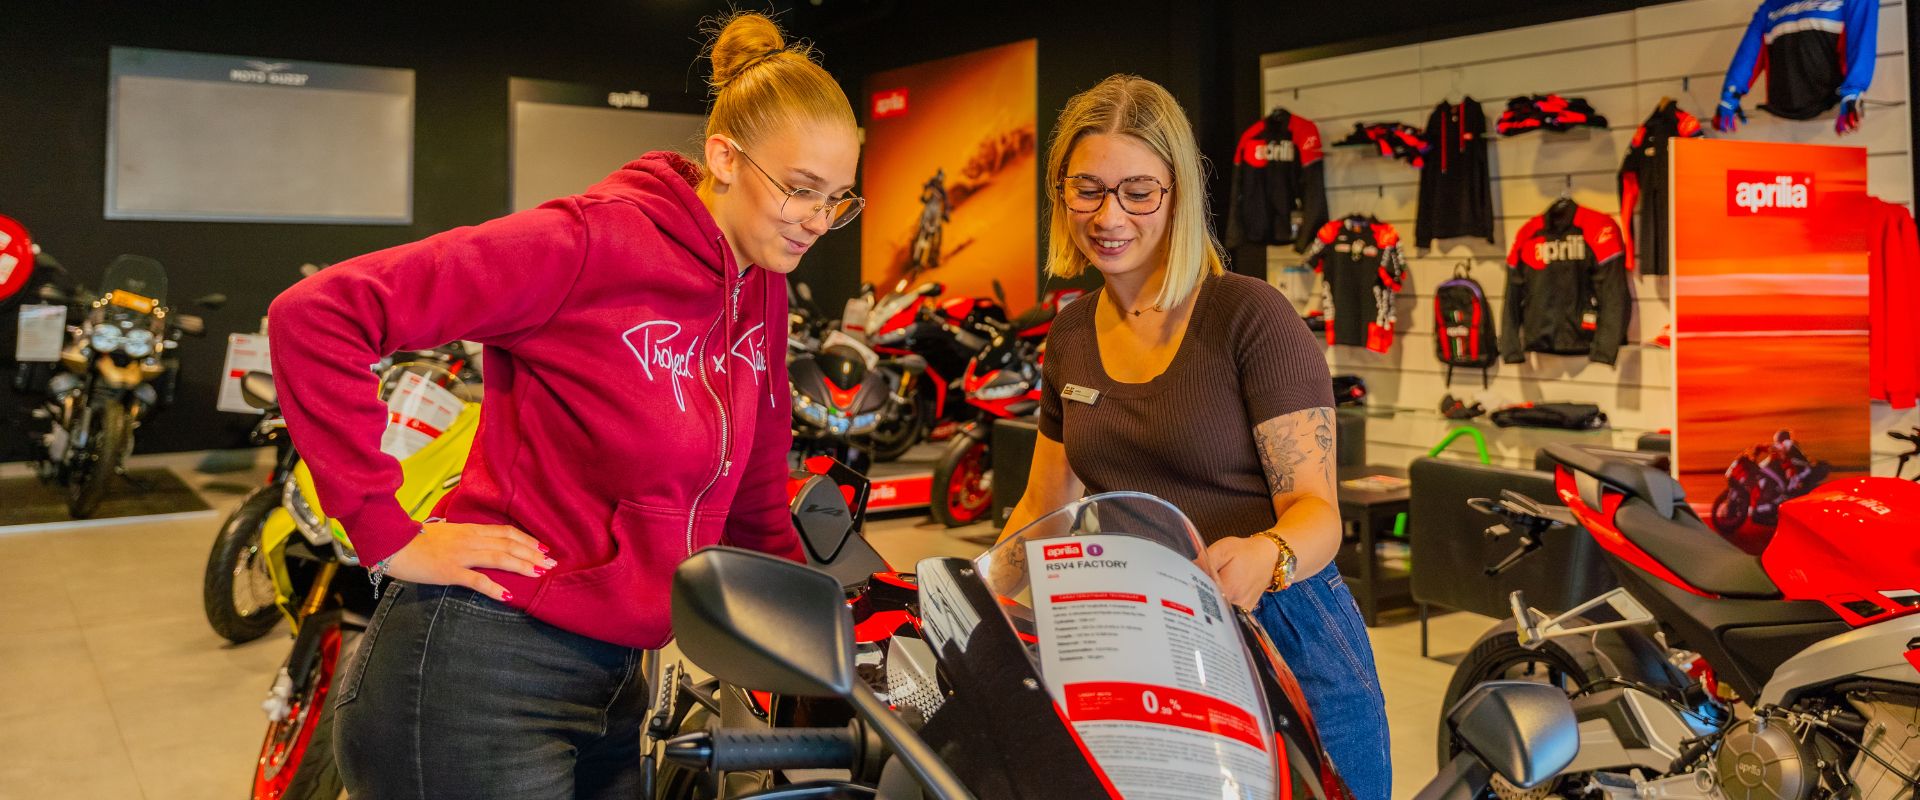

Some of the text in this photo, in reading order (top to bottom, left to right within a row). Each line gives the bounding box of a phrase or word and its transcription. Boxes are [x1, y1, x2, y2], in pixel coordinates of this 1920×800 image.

[1736, 176, 1807, 213] aprilia
[622, 320, 699, 412] Project
[1047, 546, 1080, 557] aprilia
[1046, 560, 1128, 571] RSV4 FACTORY
